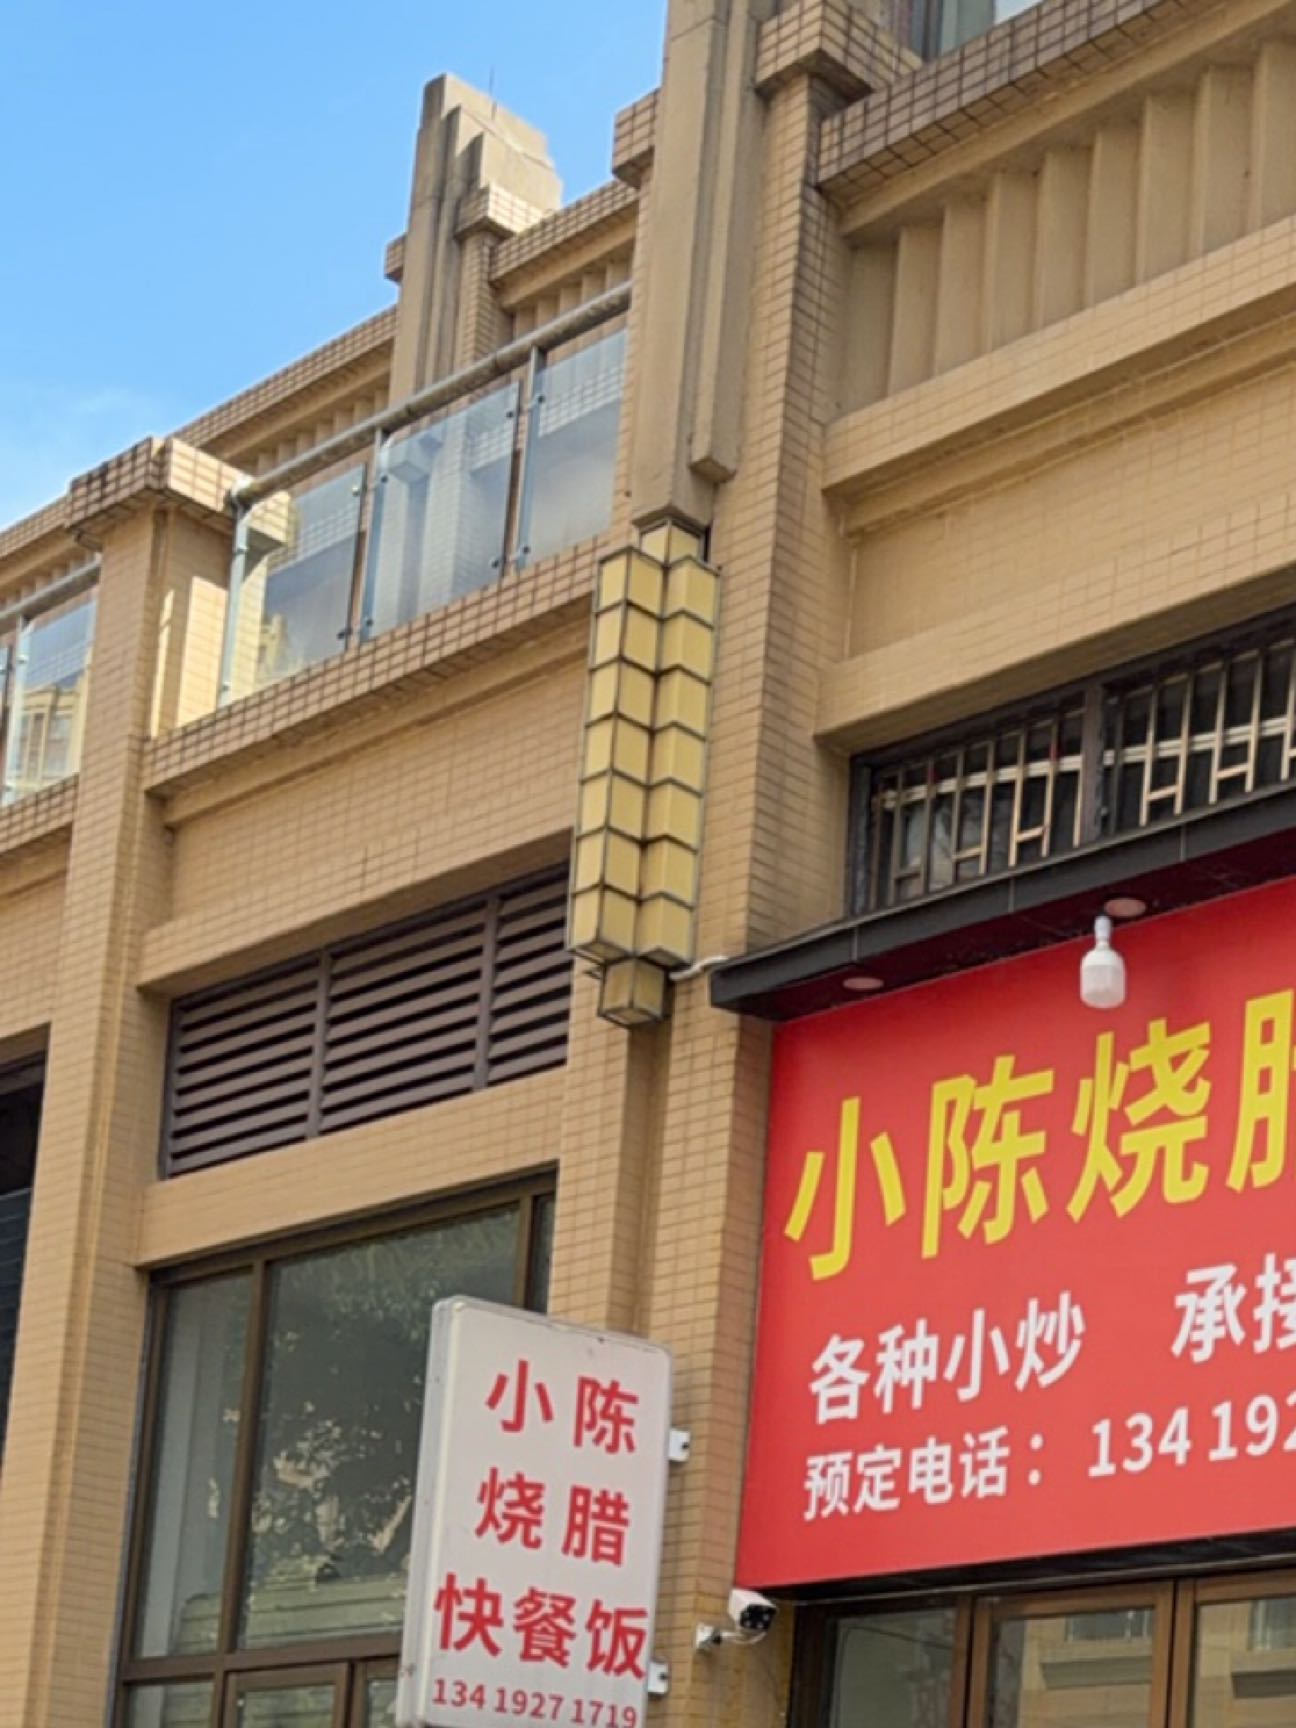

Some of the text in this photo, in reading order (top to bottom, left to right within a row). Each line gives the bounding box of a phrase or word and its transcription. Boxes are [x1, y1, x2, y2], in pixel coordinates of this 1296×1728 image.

[485, 1358, 640, 1456] 小陈
[808, 1290, 1086, 1426] 各种小炒
[475, 1465, 631, 1568] 烧腊
[432, 1571, 650, 1681] 快餐饭
